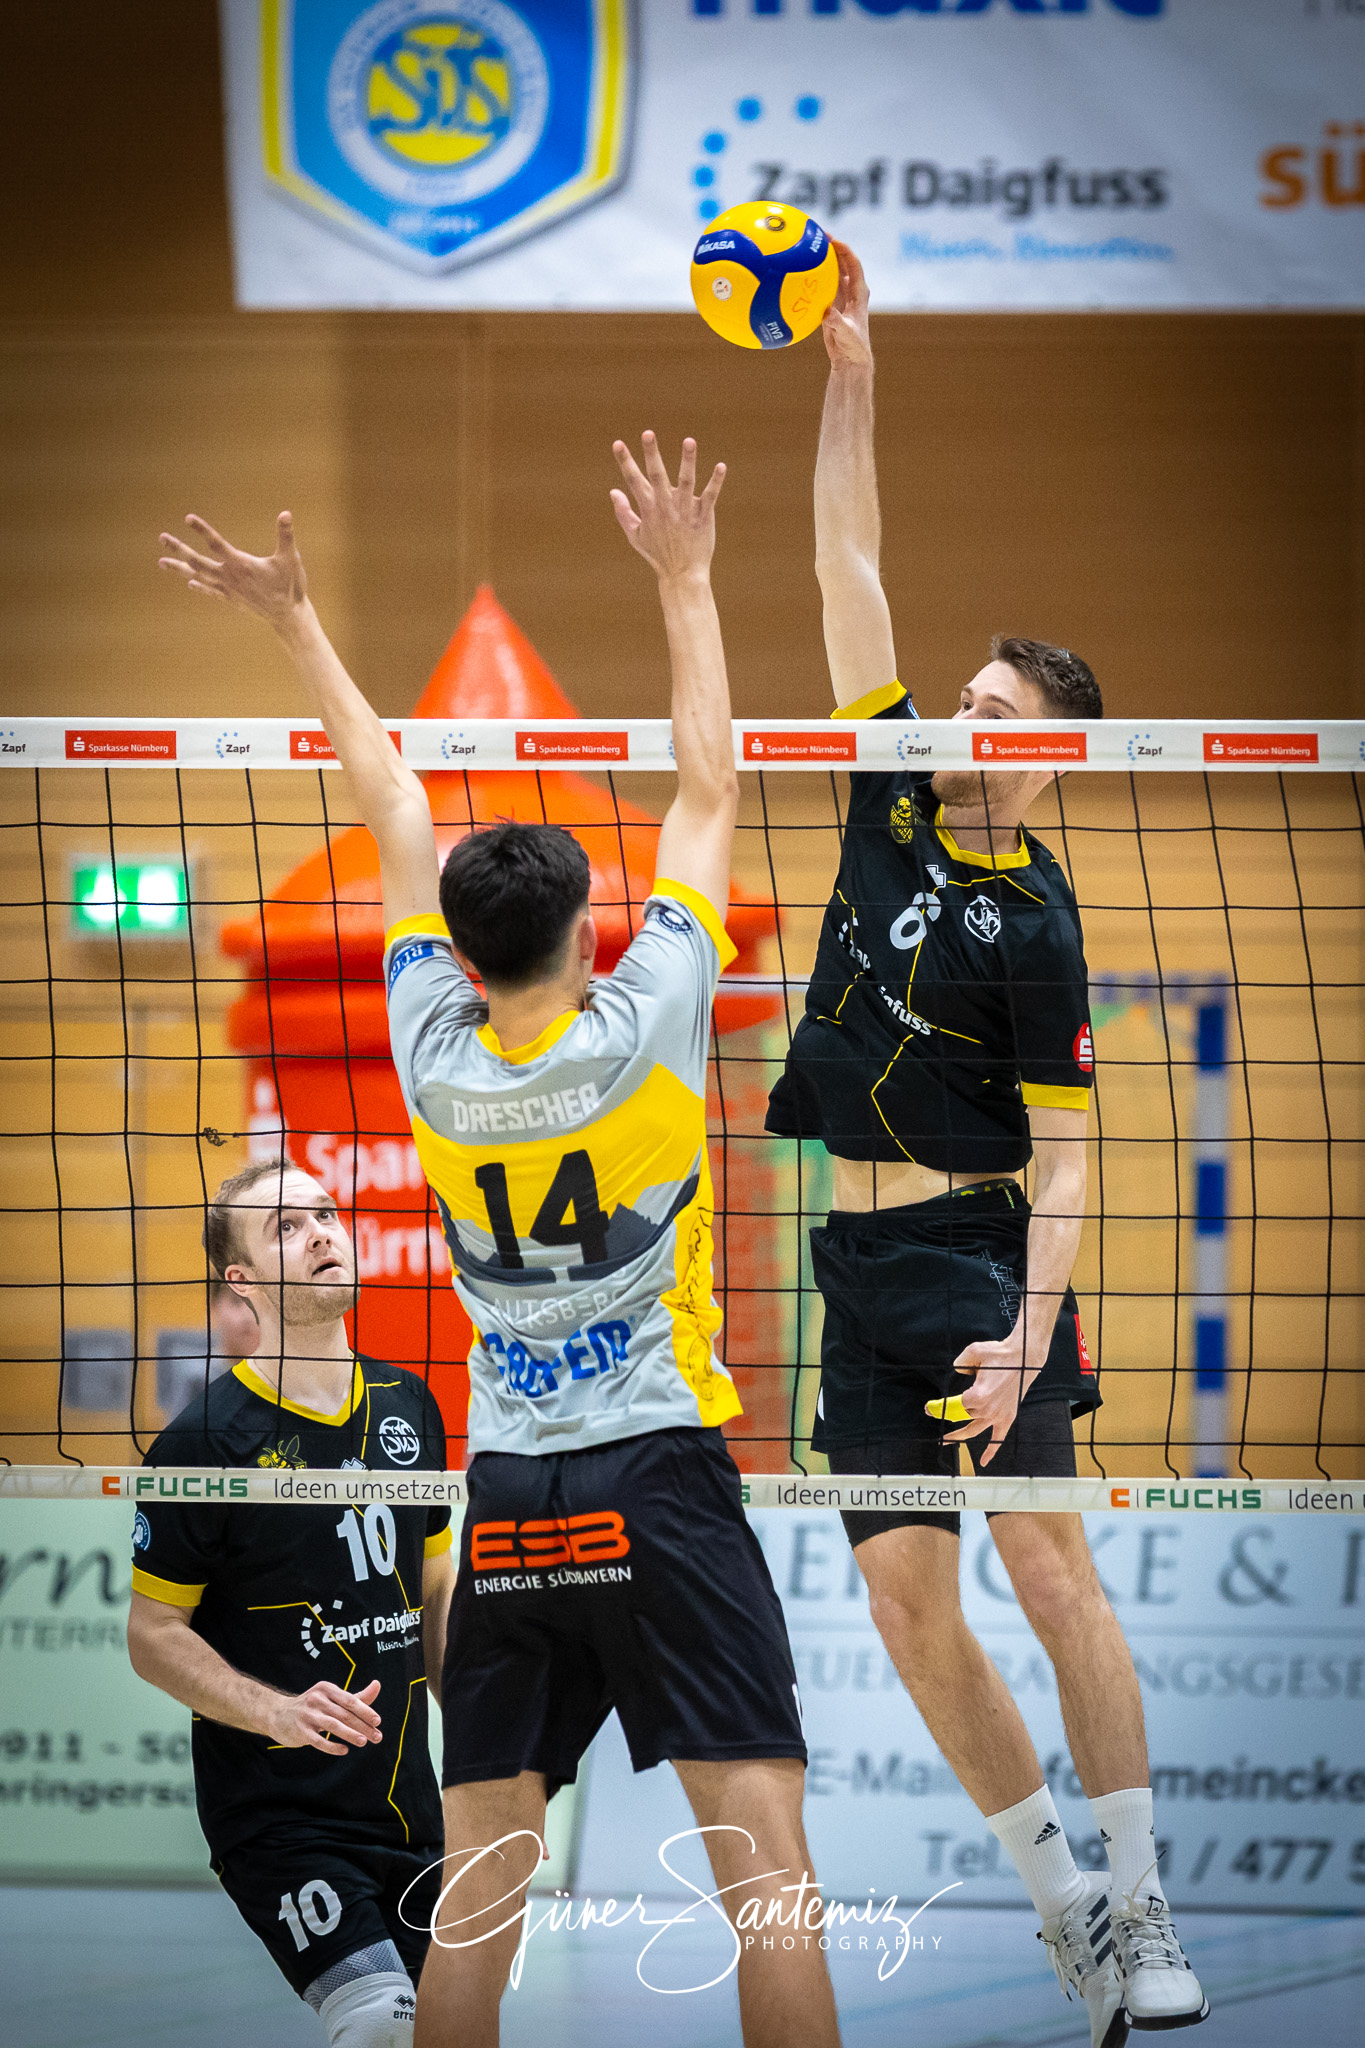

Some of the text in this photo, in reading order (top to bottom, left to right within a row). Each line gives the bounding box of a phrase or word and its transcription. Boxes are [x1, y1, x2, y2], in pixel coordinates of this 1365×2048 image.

[902, 157, 1170, 222] Daigfuss
[1, 743, 26, 754] Zapf
[88, 743, 169, 755] Sparkasse Nürnberg
[225, 743, 250, 755] Zapf
[451, 744, 477, 756] Zapf
[538, 744, 621, 756] Sparkasse Nürnberg
[766, 744, 849, 756] Sparkasse Nürnberg
[906, 745, 932, 756] Zapf
[996, 745, 1079, 757] Sparkasse Nürnberg
[1137, 745, 1163, 757] Zapf
[1227, 745, 1311, 758] Sparkasse Nürnberg
[452, 1081, 602, 1134] DRESCHER
[474, 1148, 611, 1270] 14
[136, 1477, 248, 1498] FUCHS
[274, 1477, 337, 1499] Ideen
[346, 1479, 461, 1501] umsetzen
[776, 1484, 841, 1506] Ideen
[850, 1485, 967, 1507] umsetzen
[1146, 1489, 1262, 1509] FUCHS
[1288, 1488, 1353, 1511] Ideen
[336, 1503, 397, 1582] 10
[470, 1510, 631, 1572] ESB
[474, 1566, 632, 1595] ENERGIE SÜDBAYERN
[320, 1618, 370, 1644] Zapf
[1034, 1826, 1061, 1845] adidas
[1229, 1836, 1336, 1886] 477
[278, 1879, 343, 1953] 10
[393, 2010, 415, 2021] erre
